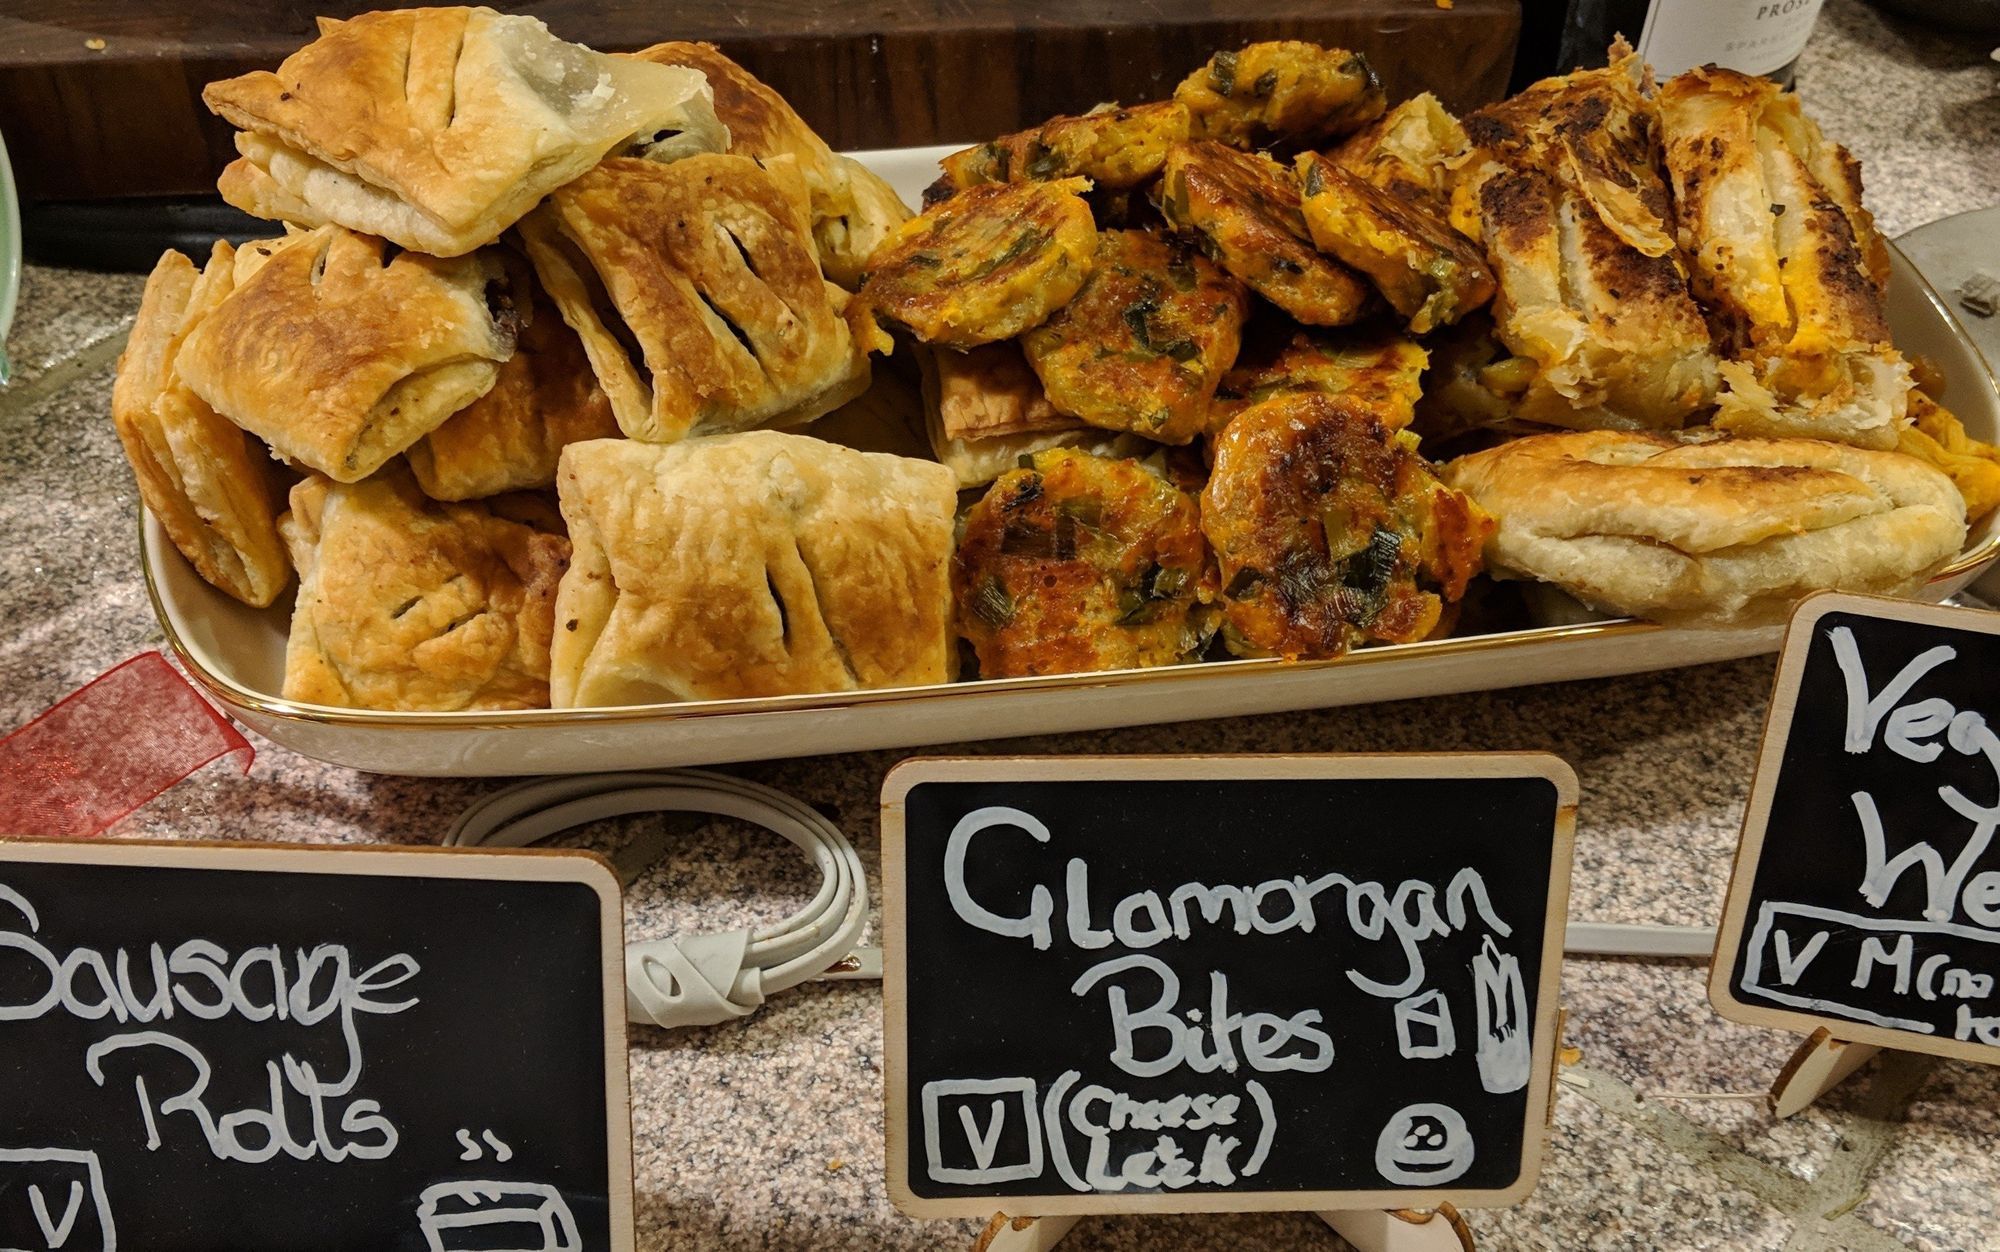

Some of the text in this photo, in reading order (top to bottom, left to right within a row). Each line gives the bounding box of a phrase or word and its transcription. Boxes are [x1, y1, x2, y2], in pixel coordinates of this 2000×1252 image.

[1071, 953, 1336, 1077] Bites
[1774, 929, 1830, 986] V
[86, 1030, 400, 1164] Rolls
